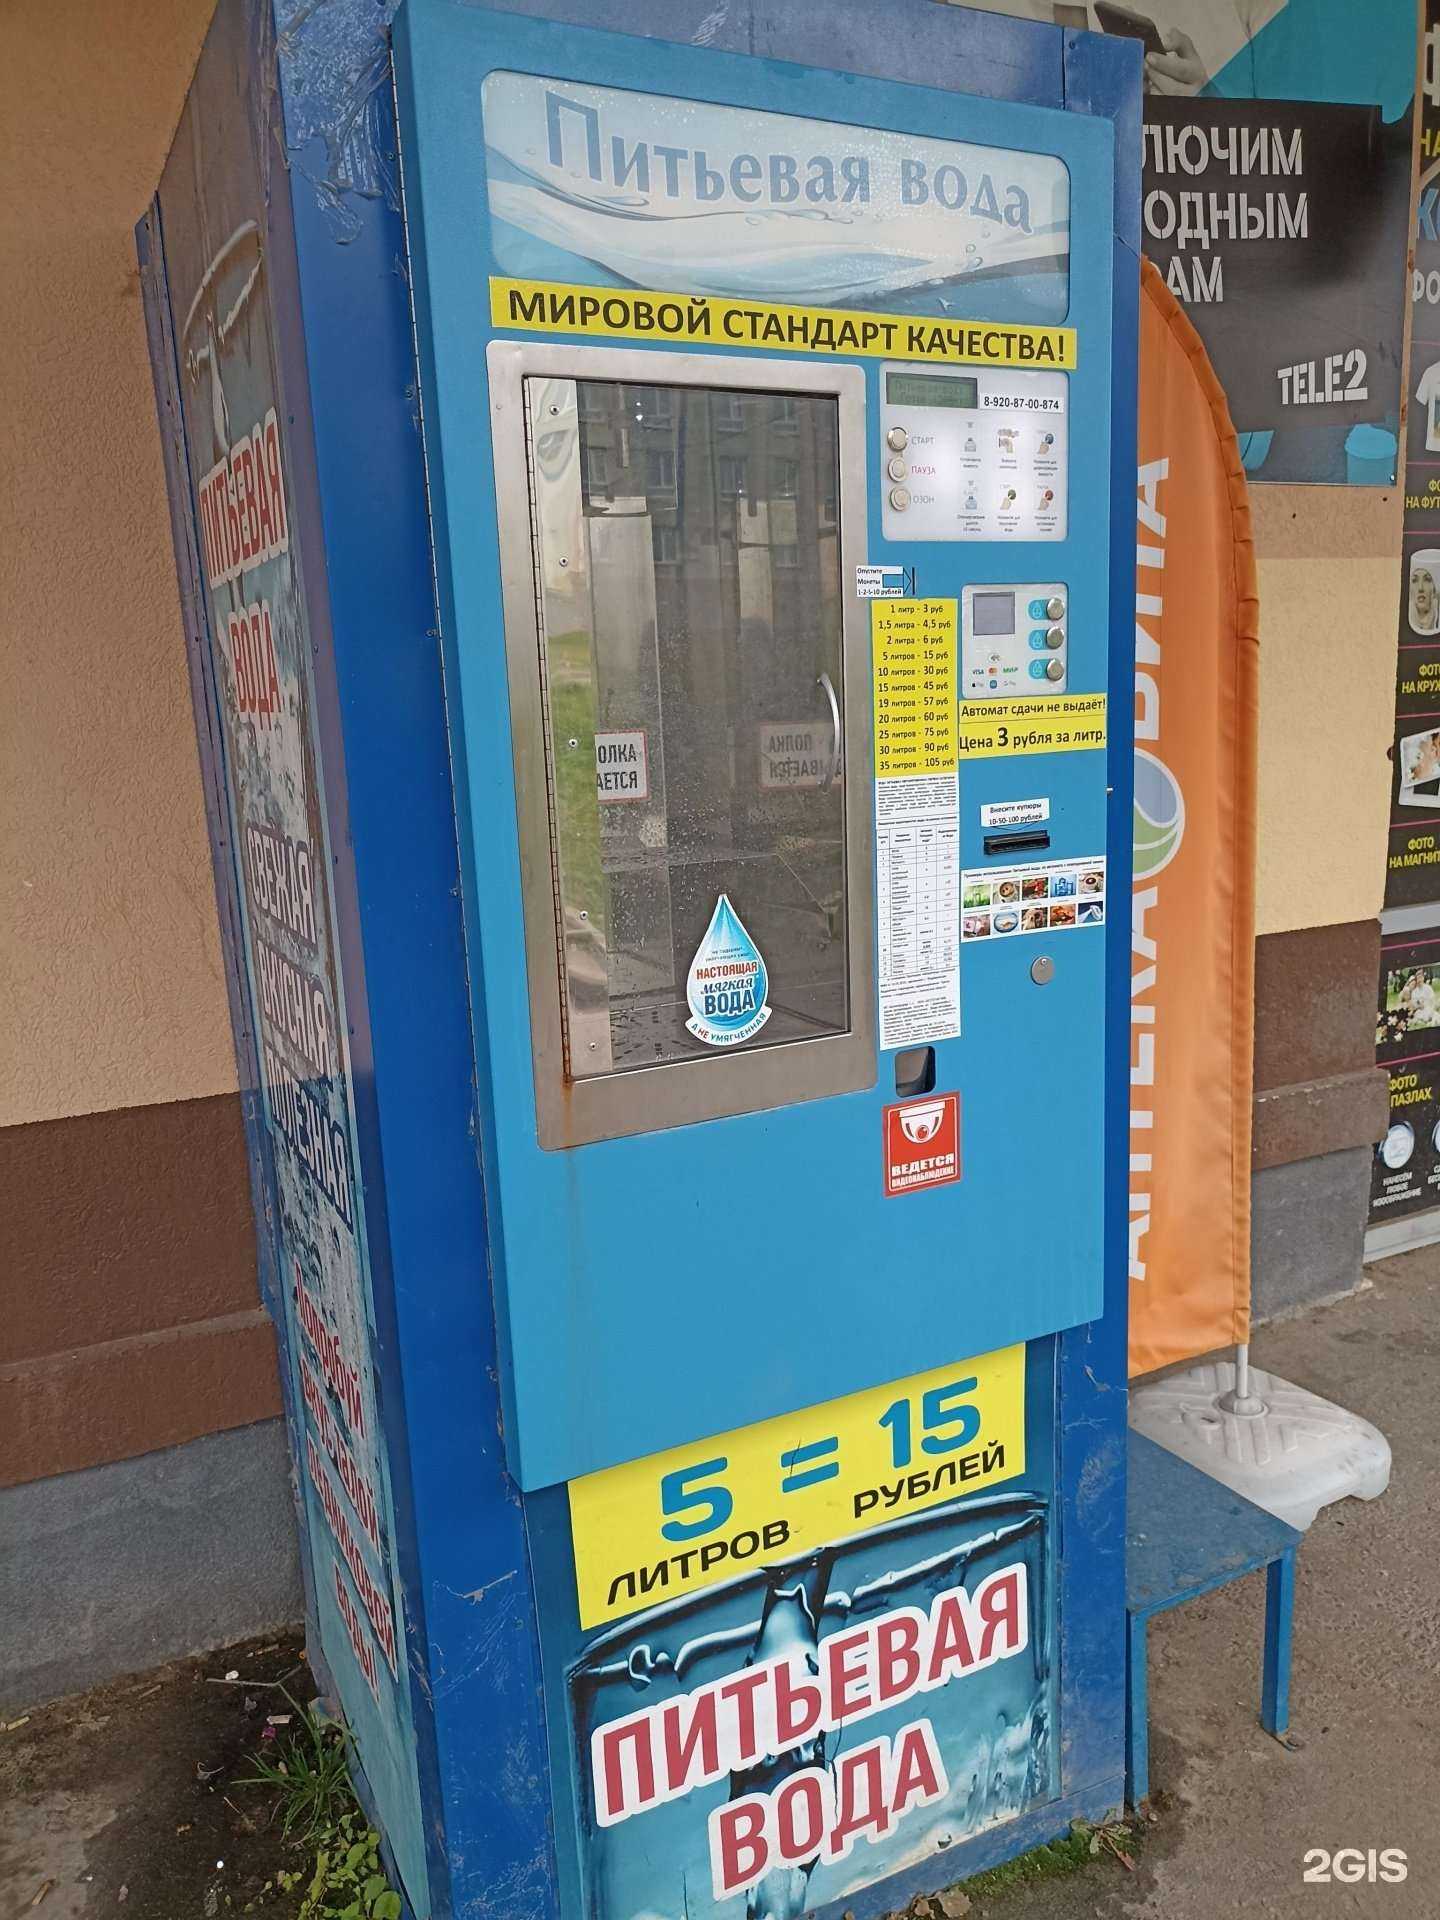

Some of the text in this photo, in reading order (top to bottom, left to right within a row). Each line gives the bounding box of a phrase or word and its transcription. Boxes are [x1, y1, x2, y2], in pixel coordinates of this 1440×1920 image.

[1142, 125, 1302, 175] ЛЮЧИМ
[545, 91, 1032, 234] Питьевая вода
[1144, 190, 1308, 249] ОДНЫМ
[1150, 256, 1223, 302] АМ
[509, 290, 1065, 361] МИРОВОЙ СТАНДАРТ КАЧЕСТВА!
[1277, 348, 1368, 404] TELE2
[984, 396, 1059, 409] 8-920-87-00-874
[912, 437, 934, 445] СТАРТ
[911, 466, 935, 475] ПАУЗА
[200, 421, 285, 580] ПИТЬЕВАЯ
[913, 496, 934, 504] ОЗОН
[1406, 495, 1420, 508] НА
[891, 605, 895, 613] 1
[923, 604, 928, 613] 3
[930, 605, 943, 613] руб
[879, 621, 891, 630] 1,5
[923, 620, 936, 629] 4,5
[938, 621, 950, 629] руб
[887, 636, 892, 644] 2
[923, 635, 928, 644] 6
[931, 636, 943, 644] руб
[883, 652, 888, 660] 5
[890, 653, 914, 661] литров
[924, 651, 933, 659] 15
[935, 652, 948, 660] руб
[229, 609, 281, 730] ВОДА
[878, 668, 888, 676] 10
[924, 666, 934, 675] 30
[935, 667, 948, 675] руб
[1419, 664, 1440, 676] ФОТ
[879, 684, 888, 692] 15
[891, 684, 915, 692] литров
[923, 682, 934, 690] 45
[935, 683, 948, 691] руб
[1401, 681, 1416, 693] НА
[879, 699, 889, 708] 19
[891, 700, 915, 708] литров
[924, 698, 934, 706] 57
[936, 698, 948, 706] руб
[962, 707, 1008, 716] Автомат
[1012, 706, 1044, 715] сдачи
[1064, 699, 1106, 711] выдаёт!
[879, 715, 889, 723] 20
[892, 715, 915, 723] литров
[924, 713, 934, 721] 60
[936, 713, 948, 721] руб
[879, 731, 889, 739] 25
[925, 728, 934, 737] 75
[936, 729, 949, 737] руб
[960, 728, 1106, 750] Цена 3 рубля за литр.
[598, 744, 637, 763] ОЛКА
[880, 746, 889, 754] 30
[892, 746, 916, 754] литров
[925, 743, 935, 752] 90
[936, 744, 949, 752] руб
[880, 762, 890, 770] 35
[892, 761, 916, 769] литров
[926, 758, 939, 767] 105
[942, 759, 954, 767] руб
[1017, 802, 1041, 813] купюры
[989, 813, 1042, 825] 10-50-100 рублей
[1408, 836, 1434, 850] ФОТО
[1389, 855, 1403, 868] НА
[247, 834, 316, 945] СВЕЖАЯ
[697, 962, 757, 979] НАСТОЯЩАЯ
[701, 978, 752, 994] мягкая
[258, 940, 332, 1079] ВКУСНАЯ
[705, 990, 754, 1015] ВОДА
[698, 1029, 708, 1038] НЕ
[711, 1013, 766, 1042] УМЯГЧЕННАЯ
[1390, 1074, 1417, 1091] ФОТО
[1391, 1087, 1433, 1107] ПАЗЛАХ
[266, 1047, 351, 1225] ПОЛЕЗНАЯ
[892, 1153, 954, 1176] ВЕДЕТСЯ
[892, 1166, 954, 1187] ВИДЕОНАБЛЮДЕНИЕ
[296, 1262, 364, 1439] Попробуй
[661, 1457, 733, 1542] 5
[879, 1376, 980, 1469] 15
[854, 1440, 1005, 1518] РУБЛЕЙ
[607, 1519, 790, 1606] ЛИТРОВ
[602, 1572, 1019, 1816] ПИТЬЕВАЯ
[719, 1728, 941, 1891] ВОДА
